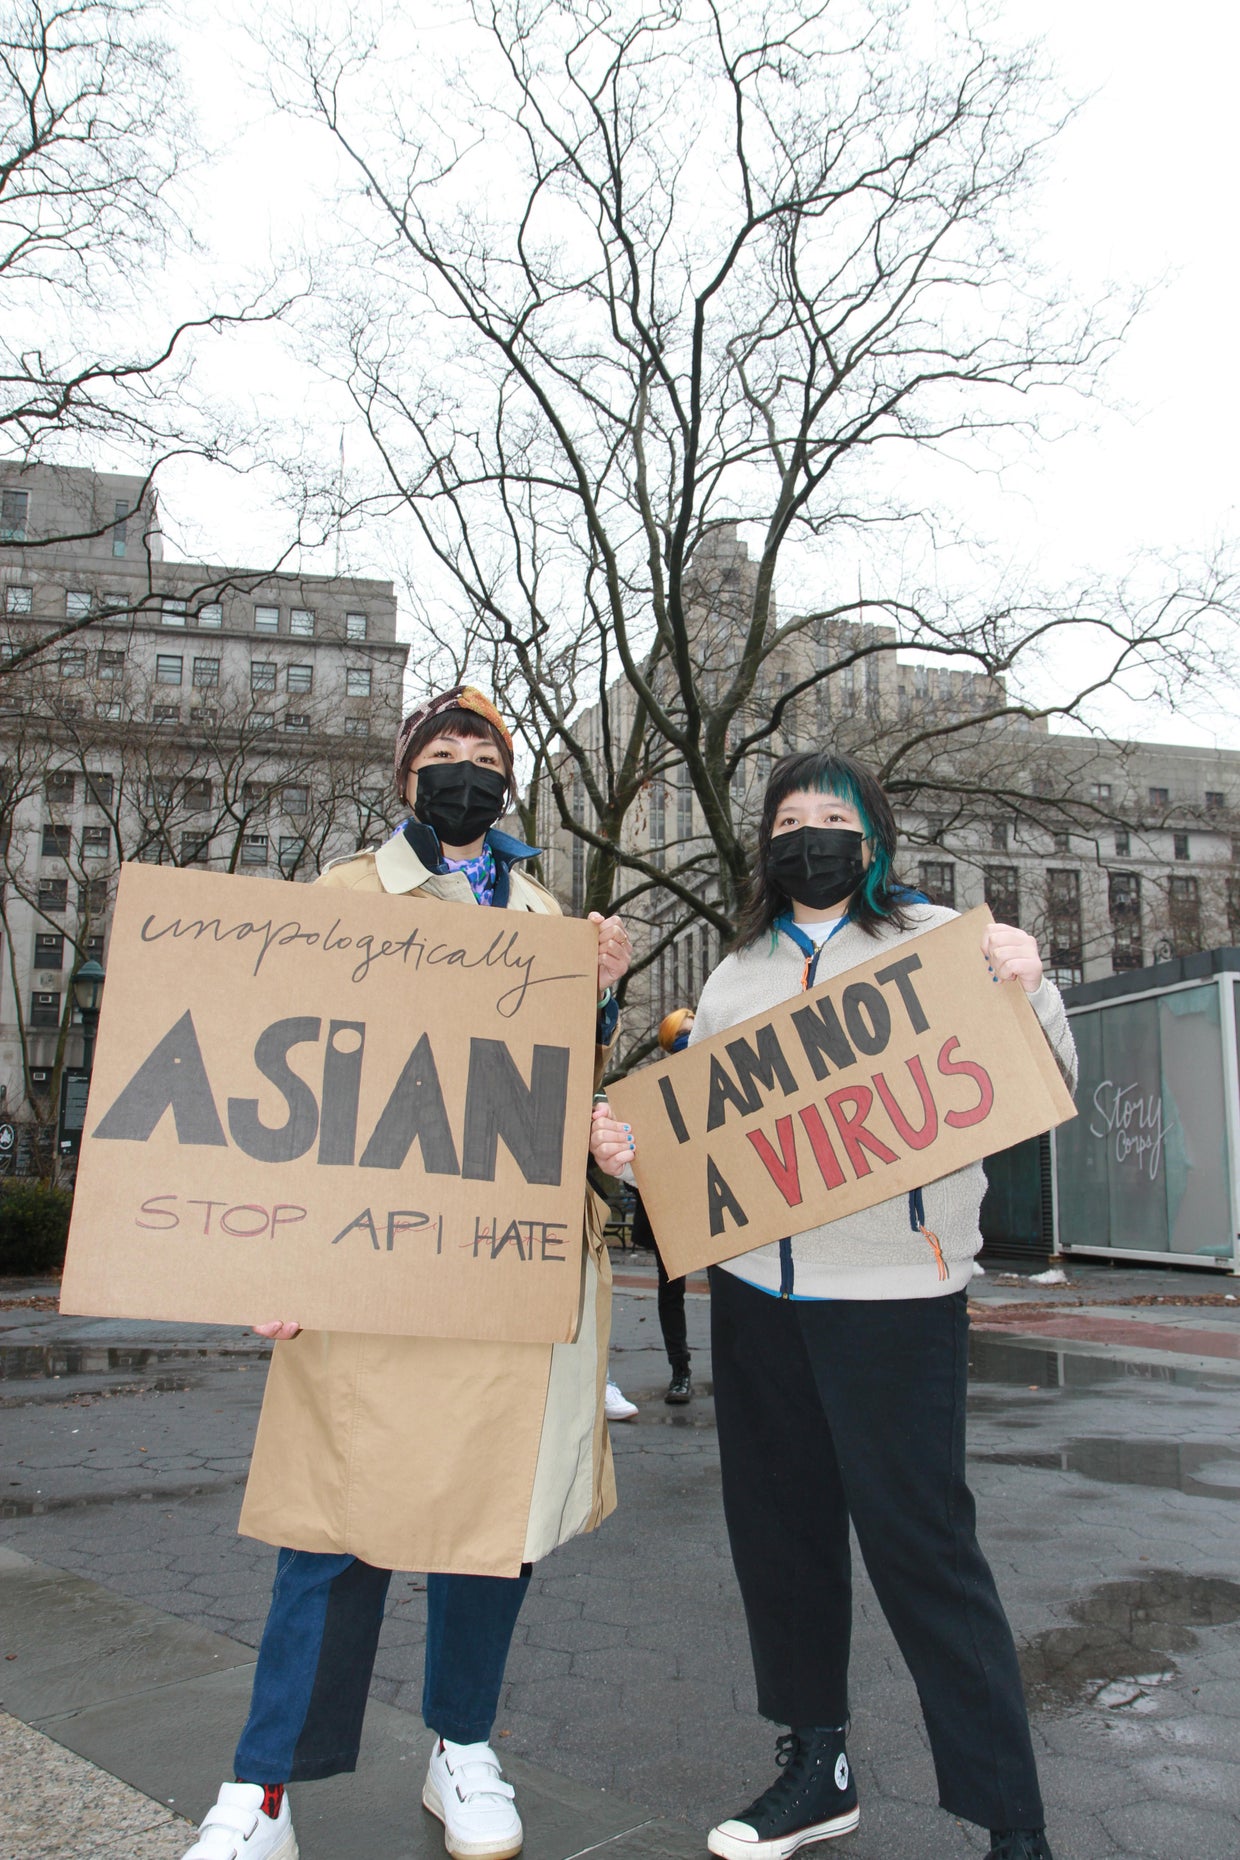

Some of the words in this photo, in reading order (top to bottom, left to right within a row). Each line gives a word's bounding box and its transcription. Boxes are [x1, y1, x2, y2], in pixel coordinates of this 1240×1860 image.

[140, 913, 590, 1018] unapologetically
[91, 1007, 571, 1187] ASIAN
[657, 1074, 691, 1145] I
[705, 1022, 800, 1134] AM
[790, 952, 932, 1082] NOT
[706, 1152, 750, 1238] A
[745, 1035, 995, 1208] VIRUS
[1089, 1080, 1174, 1180] Story
[135, 1194, 308, 1241] STOP
[330, 1206, 444, 1255] API
[473, 1215, 568, 1262] HATE
